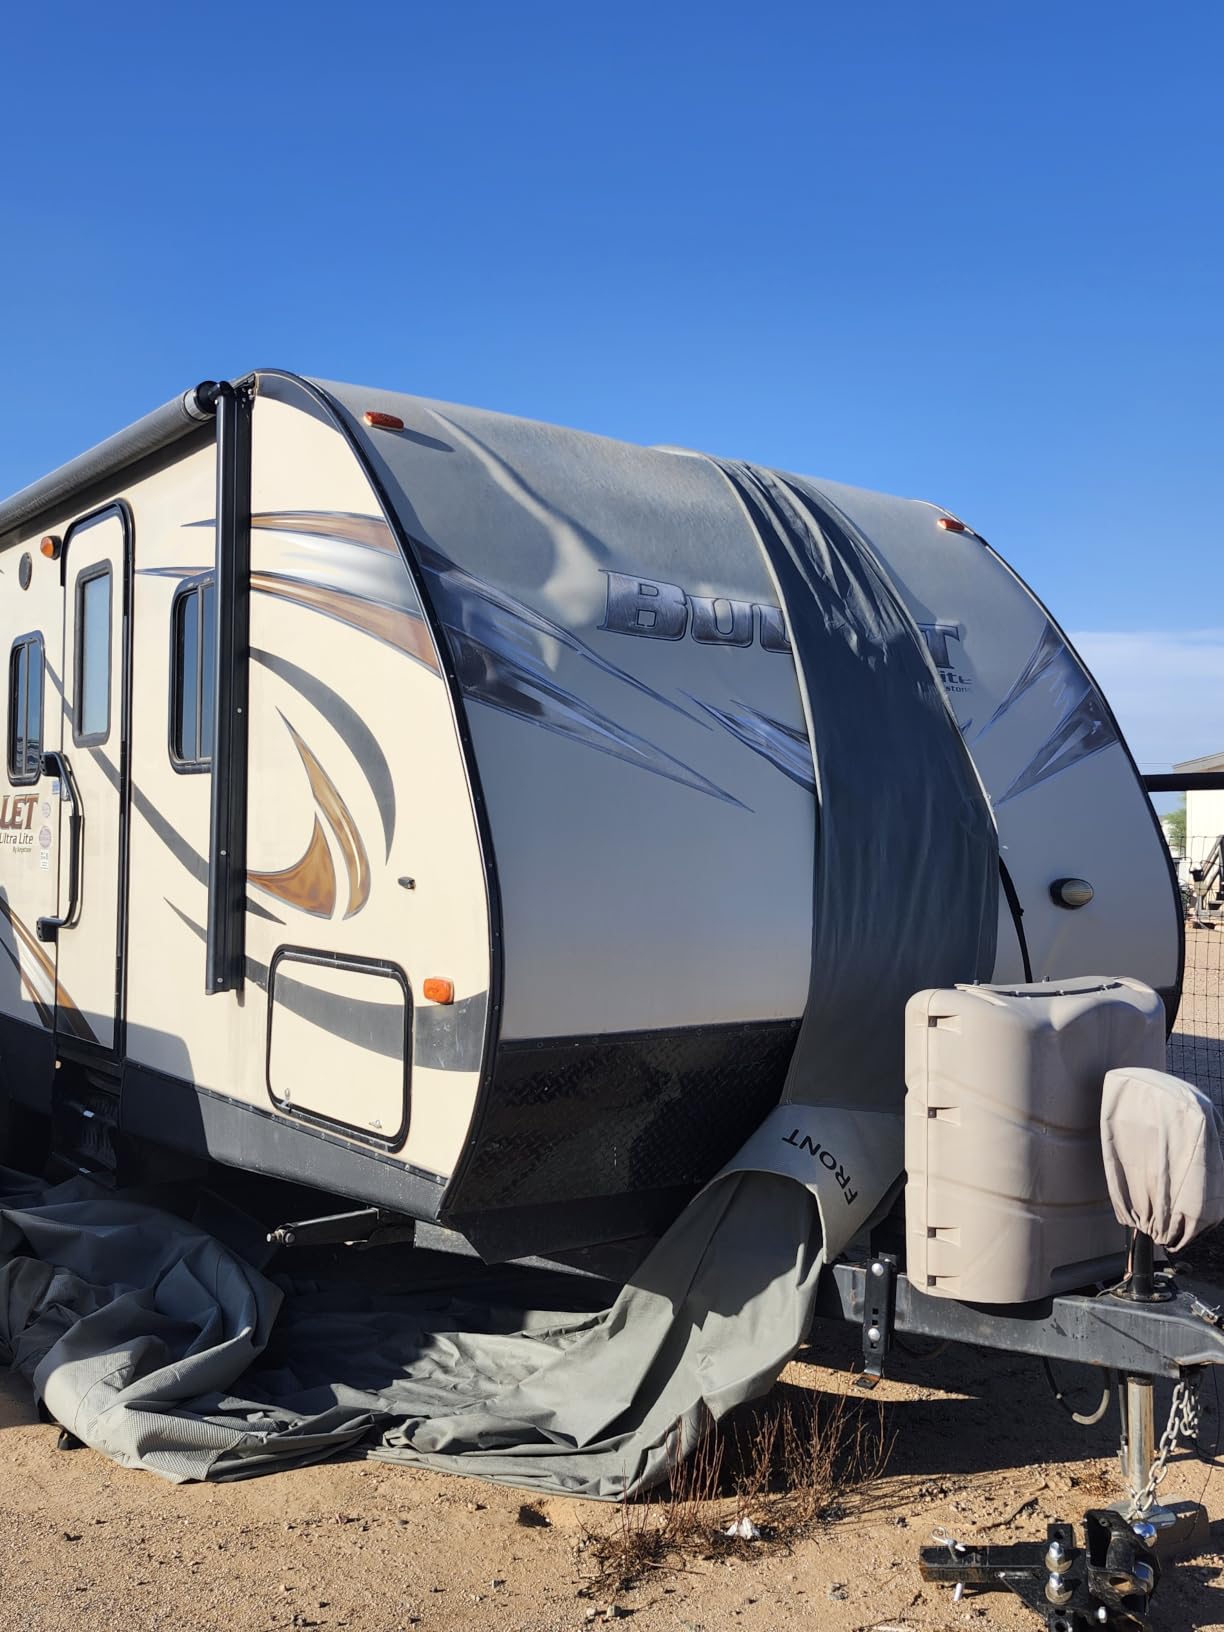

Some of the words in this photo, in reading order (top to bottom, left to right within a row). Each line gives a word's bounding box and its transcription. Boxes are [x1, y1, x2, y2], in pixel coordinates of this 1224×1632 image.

[939, 670, 973, 685] ite
[19, 833, 34, 845] Lite
[782, 1128, 858, 1206] FRONT
